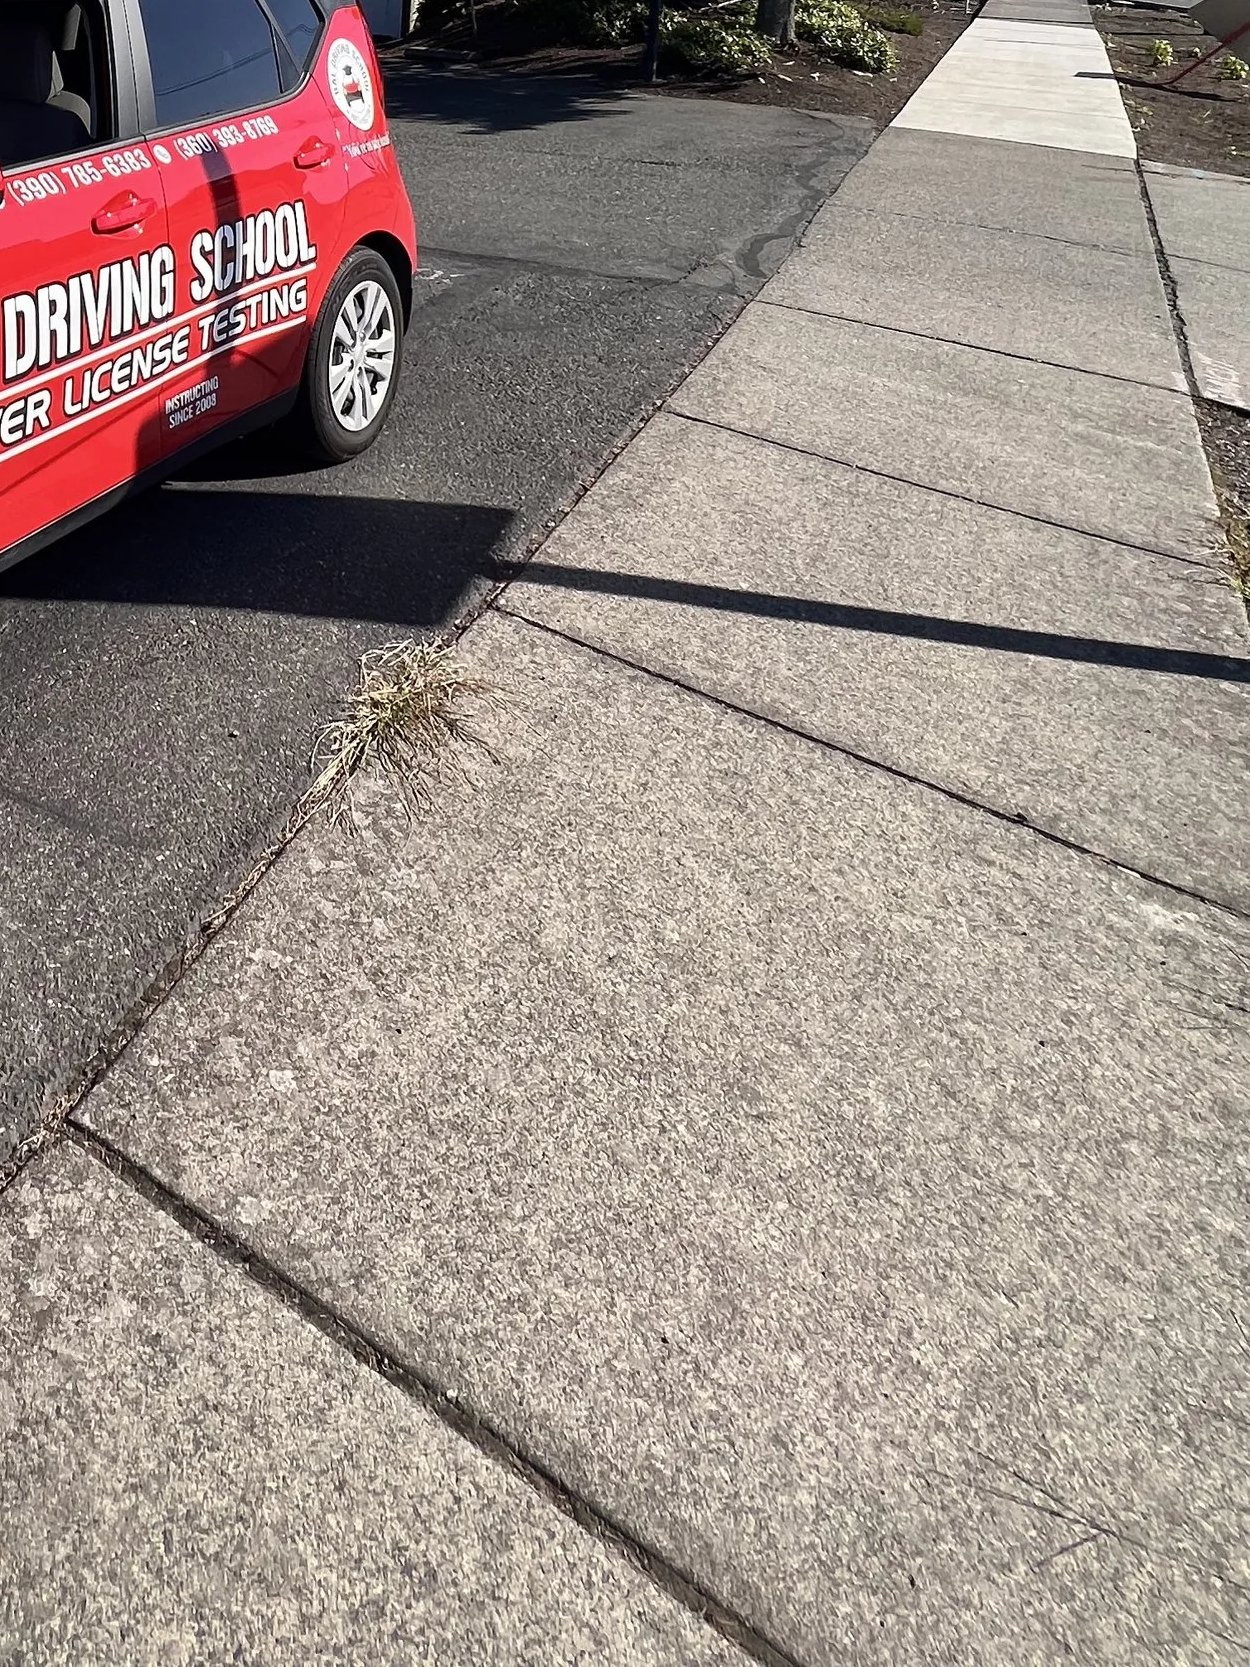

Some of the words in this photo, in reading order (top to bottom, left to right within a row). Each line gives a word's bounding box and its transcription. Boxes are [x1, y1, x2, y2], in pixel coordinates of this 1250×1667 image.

[61, 148, 152, 188] 785-6383
[173, 132, 218, 161] (360)
[212, 115, 279, 148] 393-8769
[2, 243, 176, 383] DRIVING
[190, 199, 317, 302] SCHOOL
[63, 324, 190, 417] LICENSE
[198, 278, 308, 351] TESTING
[165, 375, 219, 414] INSTRUCTING
[169, 404, 194, 429] SINCE
[195, 393, 217, 415] 2008
